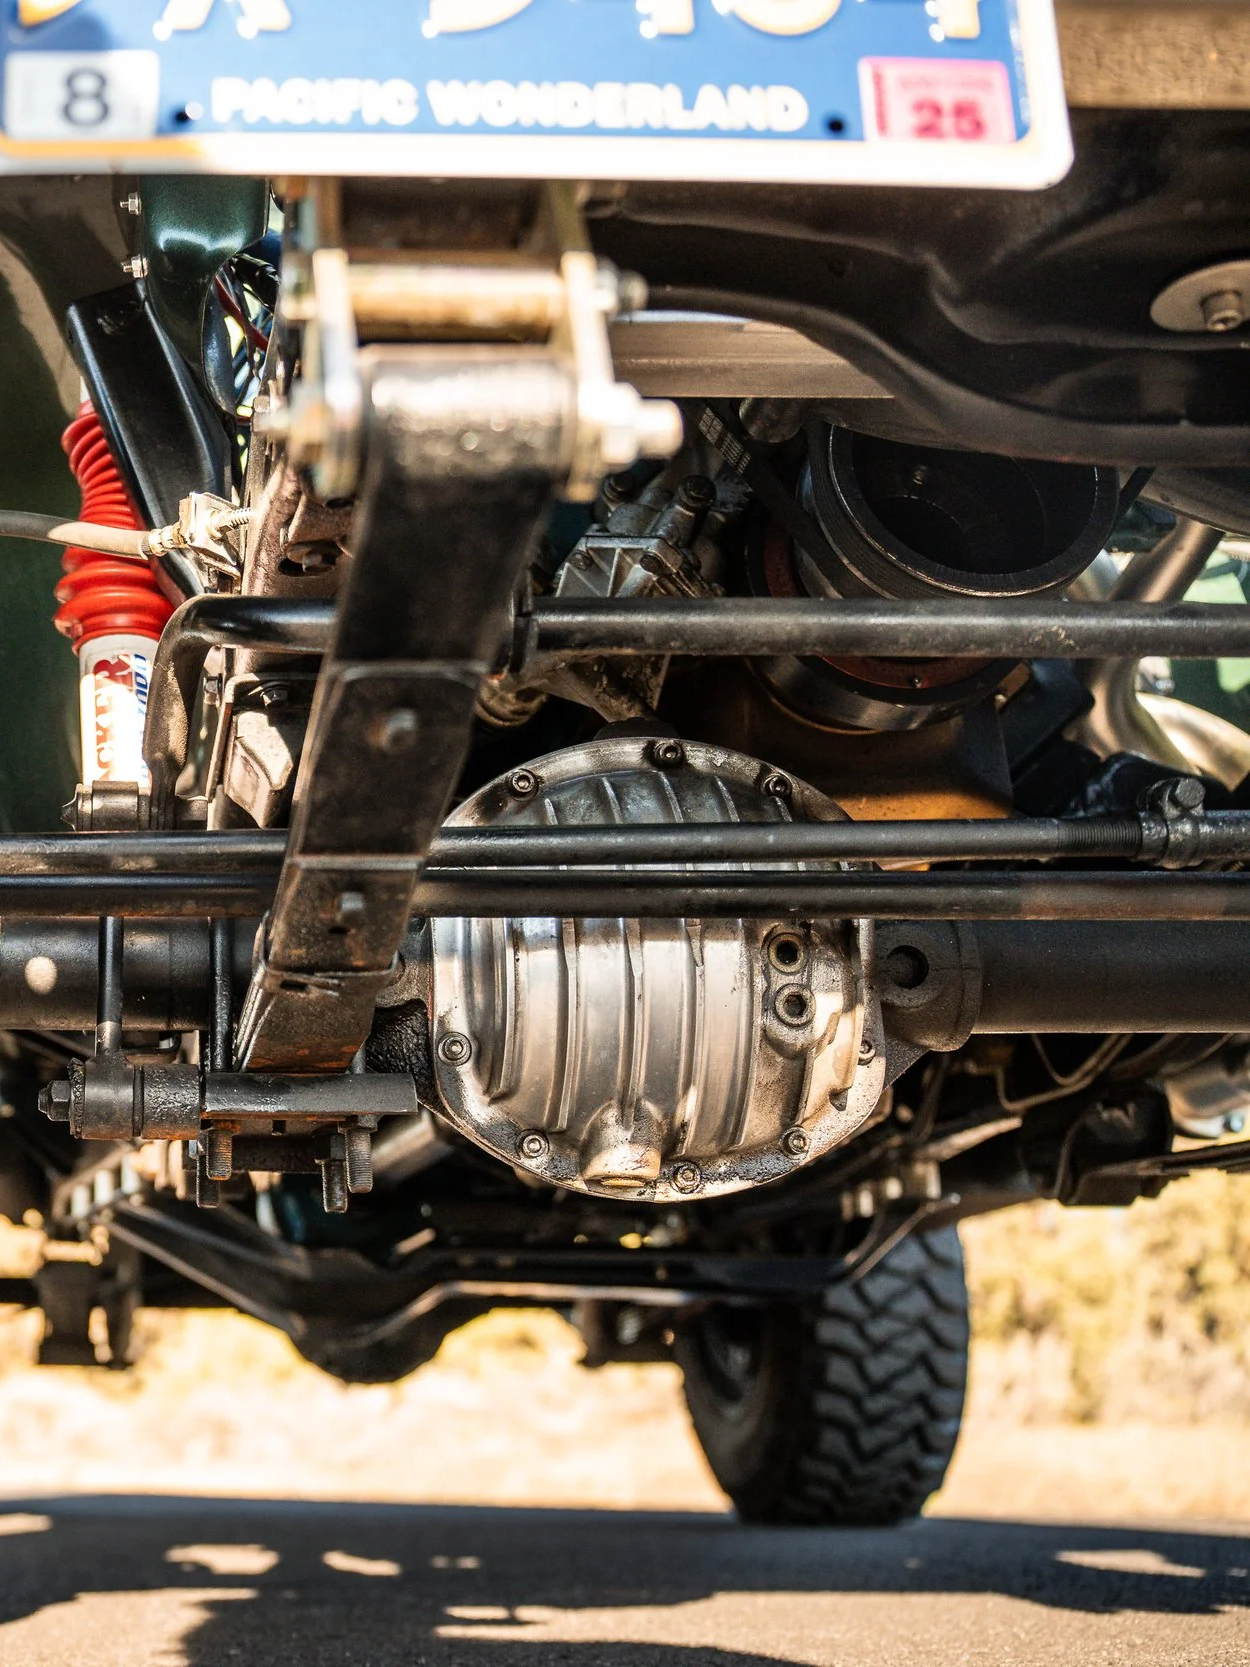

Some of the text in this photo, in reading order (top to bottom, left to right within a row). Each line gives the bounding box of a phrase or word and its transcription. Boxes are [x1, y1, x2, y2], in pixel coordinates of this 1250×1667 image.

[63, 66, 110, 127] 8
[211, 77, 419, 128] PACIFIC
[427, 79, 809, 133] WONDERLAND
[912, 98, 985, 141] 25
